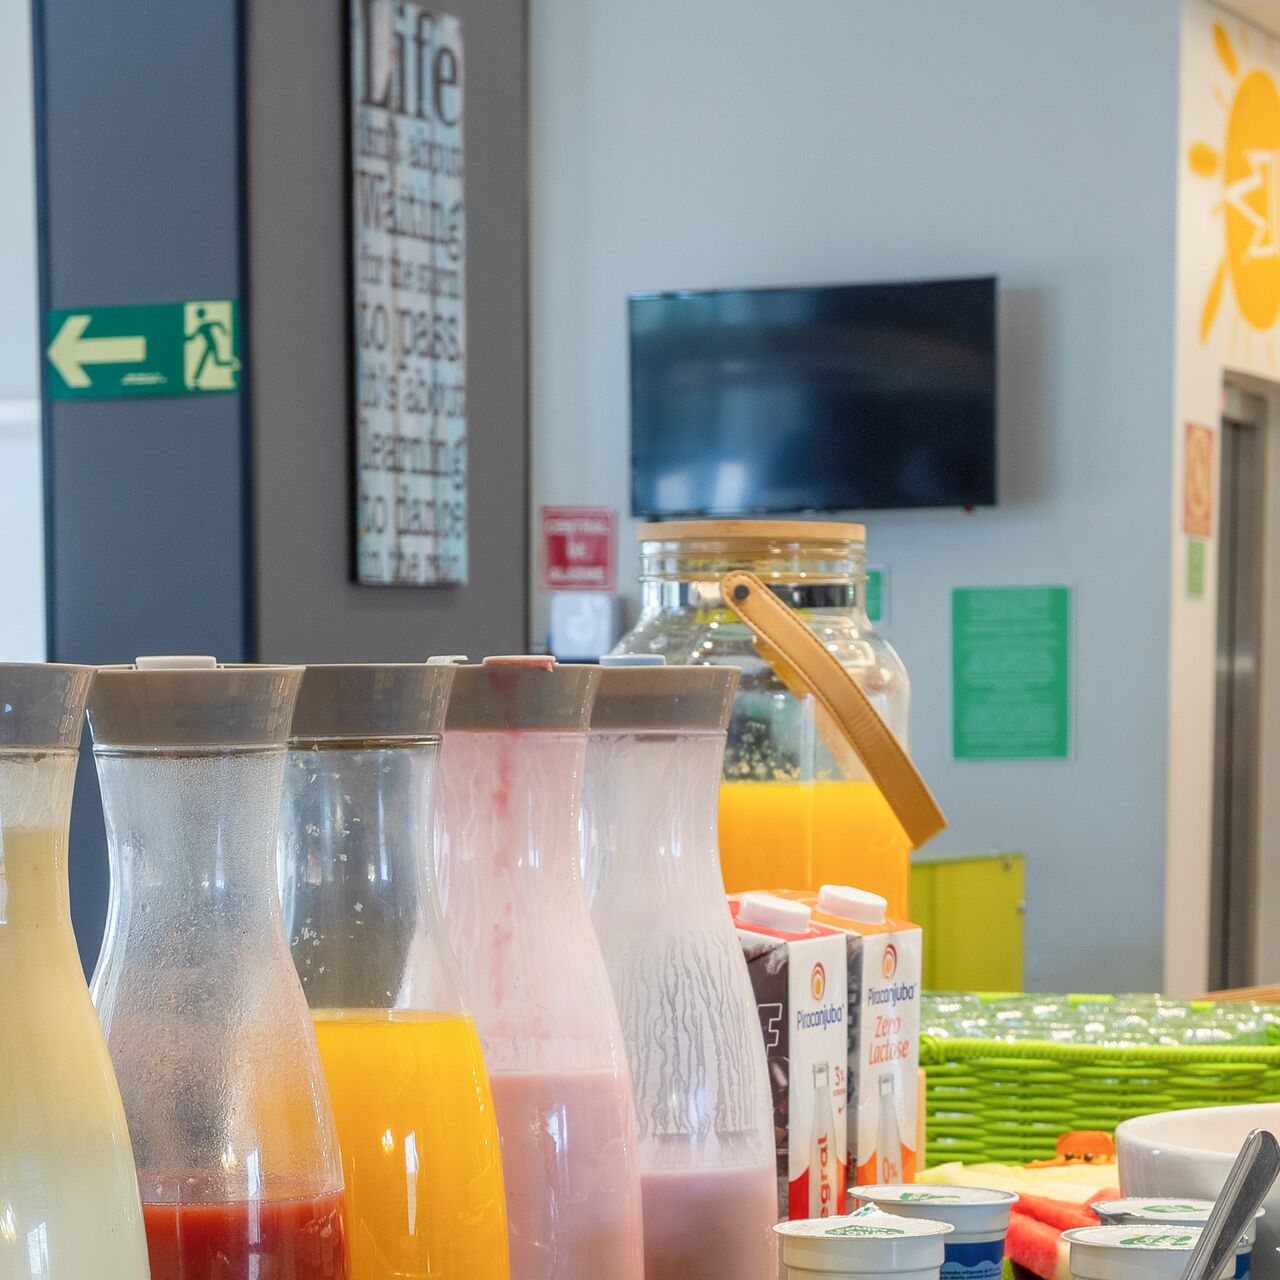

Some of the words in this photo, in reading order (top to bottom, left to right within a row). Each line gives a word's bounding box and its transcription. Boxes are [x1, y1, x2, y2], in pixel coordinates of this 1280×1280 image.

[361, 2, 463, 127] Life
[868, 984, 915, 1007] Piracanjuba
[797, 1006, 842, 1032] Piracanjuba
[875, 1015, 900, 1038] Zero
[869, 1039, 910, 1065] Lactose
[882, 1156, 898, 1184] 0%
